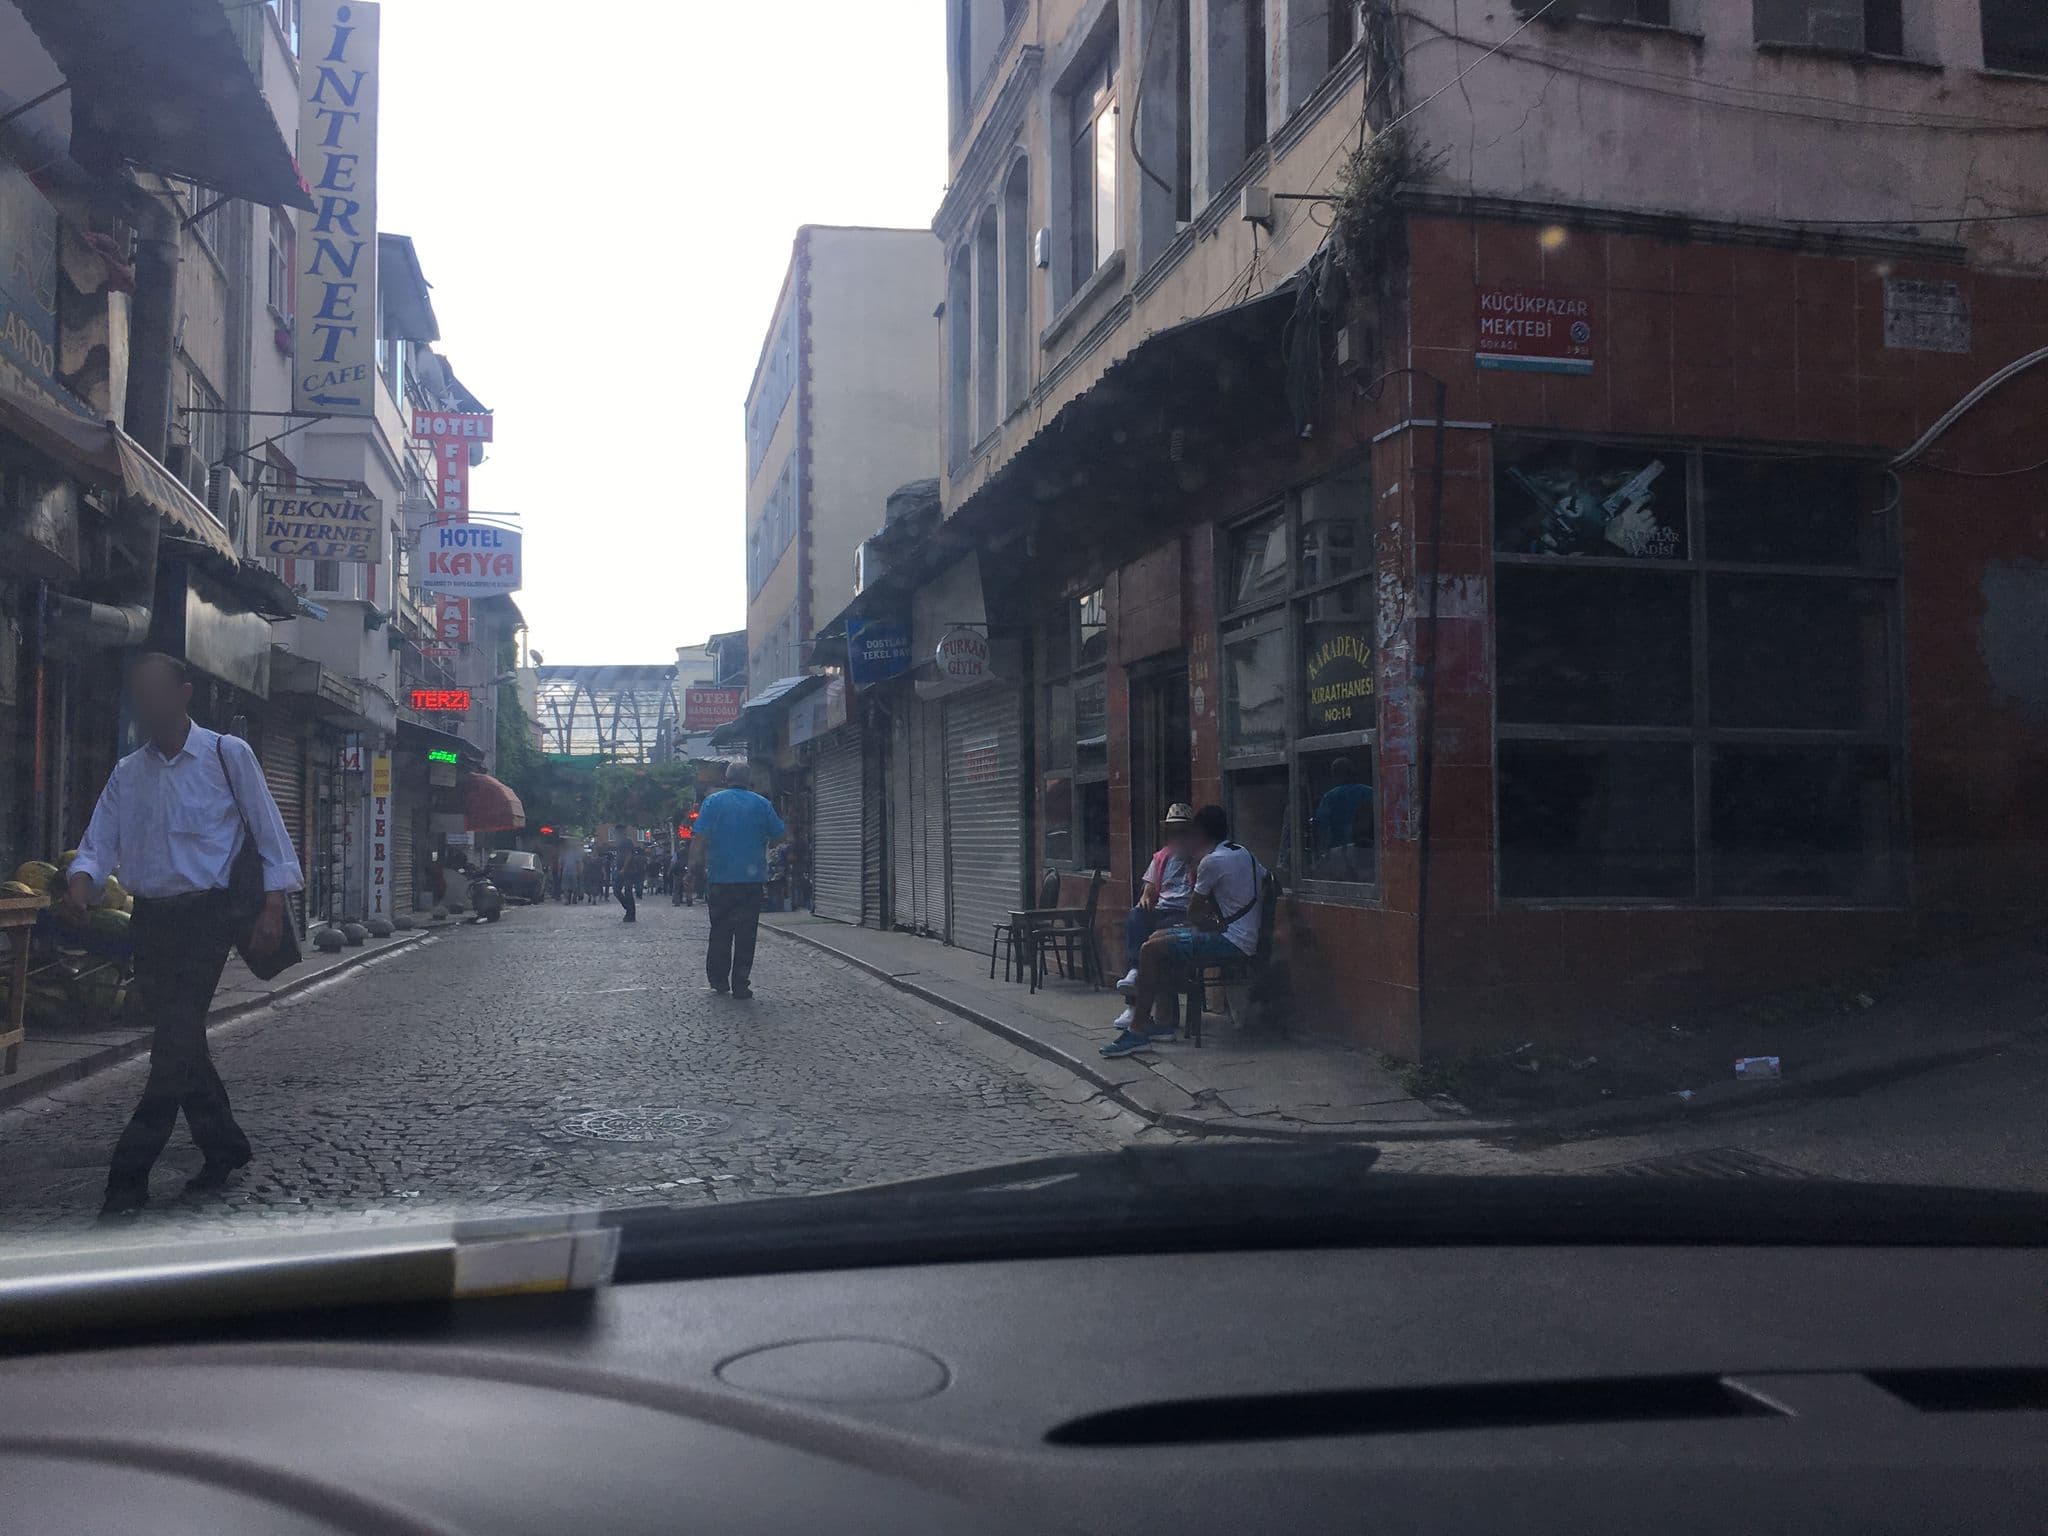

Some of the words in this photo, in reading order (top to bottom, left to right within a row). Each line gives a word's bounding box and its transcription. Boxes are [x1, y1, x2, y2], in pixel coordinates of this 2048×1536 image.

[1480, 291, 1589, 316] KÜÇÜKPAZAR
[1480, 318, 1552, 338] MEKTEBİ
[303, 364, 367, 392] CAFE
[415, 417, 489, 439] HOTEL
[263, 498, 371, 522] TEKNİK
[265, 517, 377, 544] İNTERNET
[440, 528, 504, 549] HOTEL
[270, 539, 369, 559] CAFE
[429, 551, 514, 577] KAYA
[863, 650, 892, 660] TEKEL
[943, 639, 987, 661] FURKAN
[1309, 635, 1371, 681] KARADENİZ
[948, 659, 983, 675] GİYİM
[693, 693, 734, 704] OTEL
[1311, 672, 1374, 705] KIRAATHANESİ
[412, 691, 469, 709] TERZİ
[1324, 706, 1352, 722] NO:14
[374, 796, 387, 914] TERZİ
